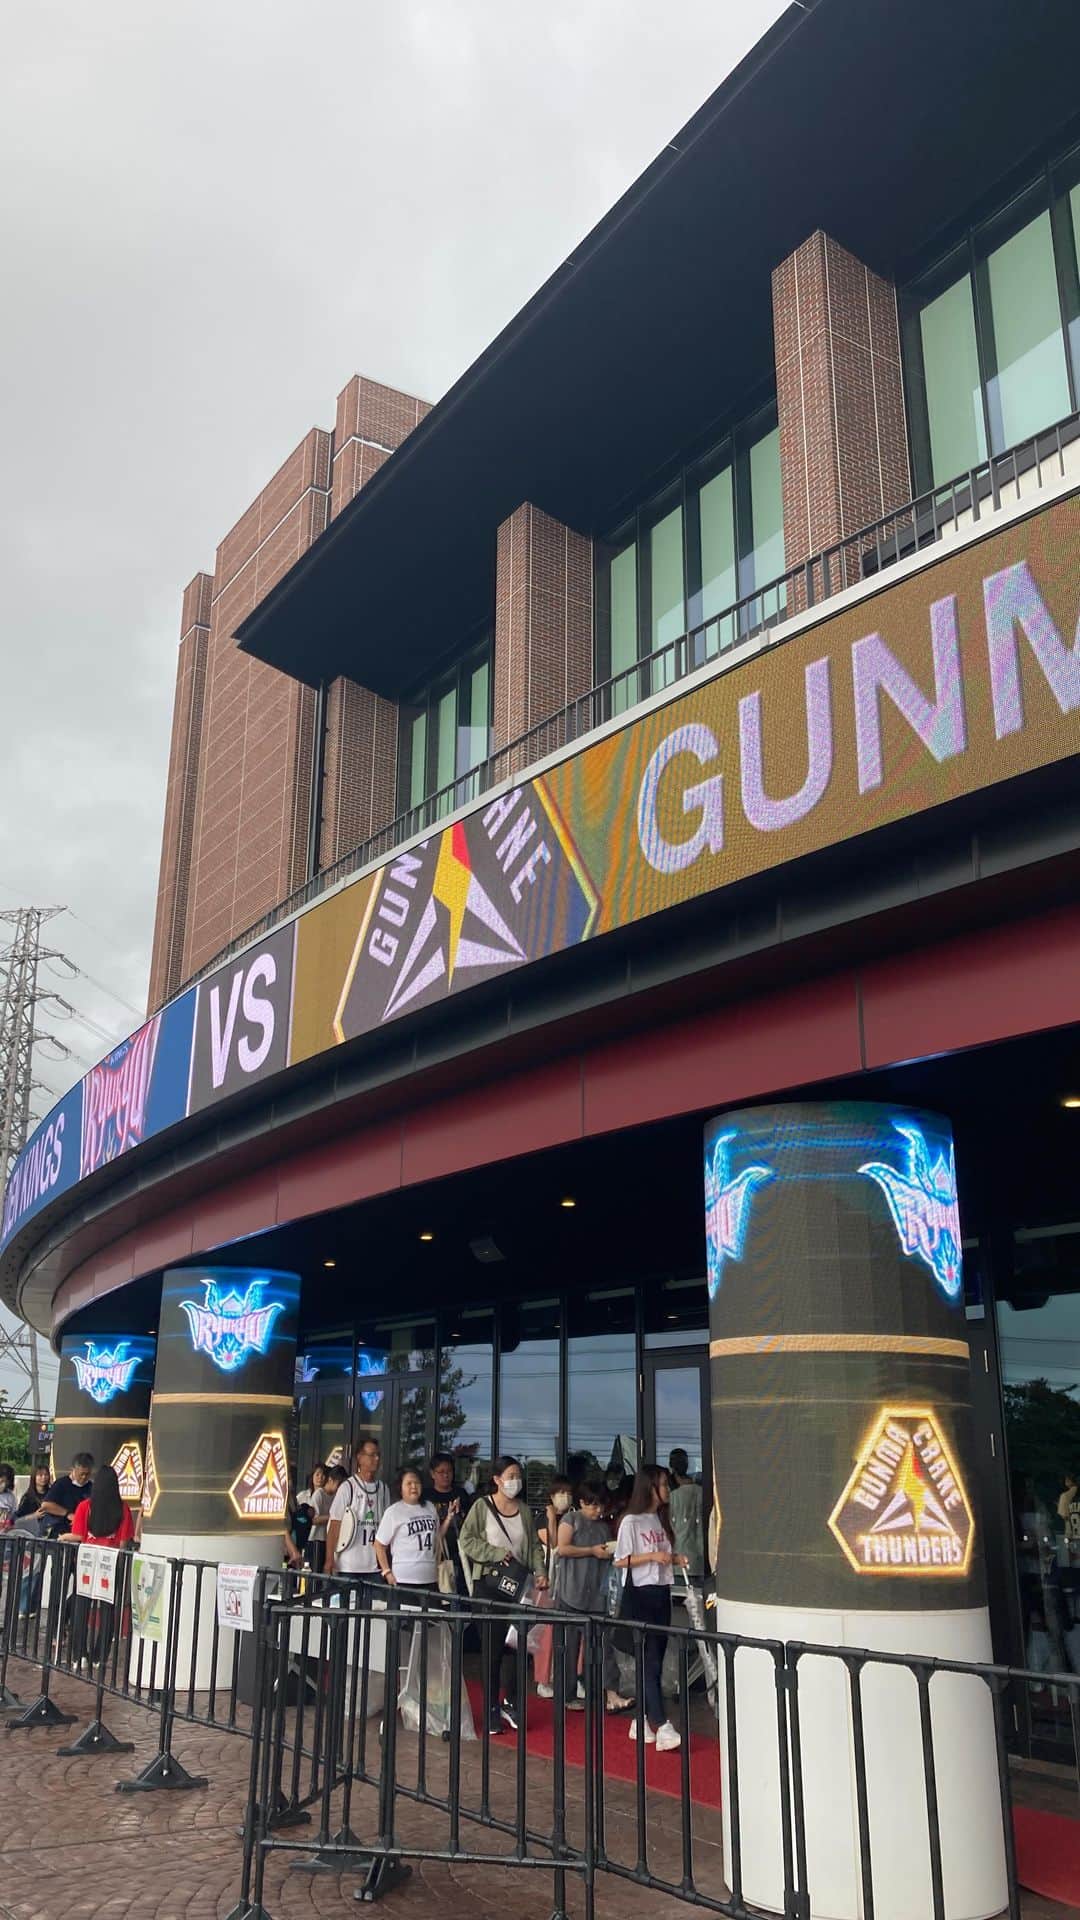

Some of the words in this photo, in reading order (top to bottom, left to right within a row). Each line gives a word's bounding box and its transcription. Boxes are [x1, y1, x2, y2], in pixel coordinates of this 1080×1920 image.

[210, 953, 277, 1089] VS
[19, 1112, 65, 1217] KINGS
[853, 1423, 911, 1510] GUNMA
[912, 1421, 961, 1511] CRANE
[362, 1529, 376, 1547] 14
[416, 1532, 433, 1552] 14
[860, 1534, 963, 1564] THUNDERS
[500, 1578, 517, 1593] Lee
